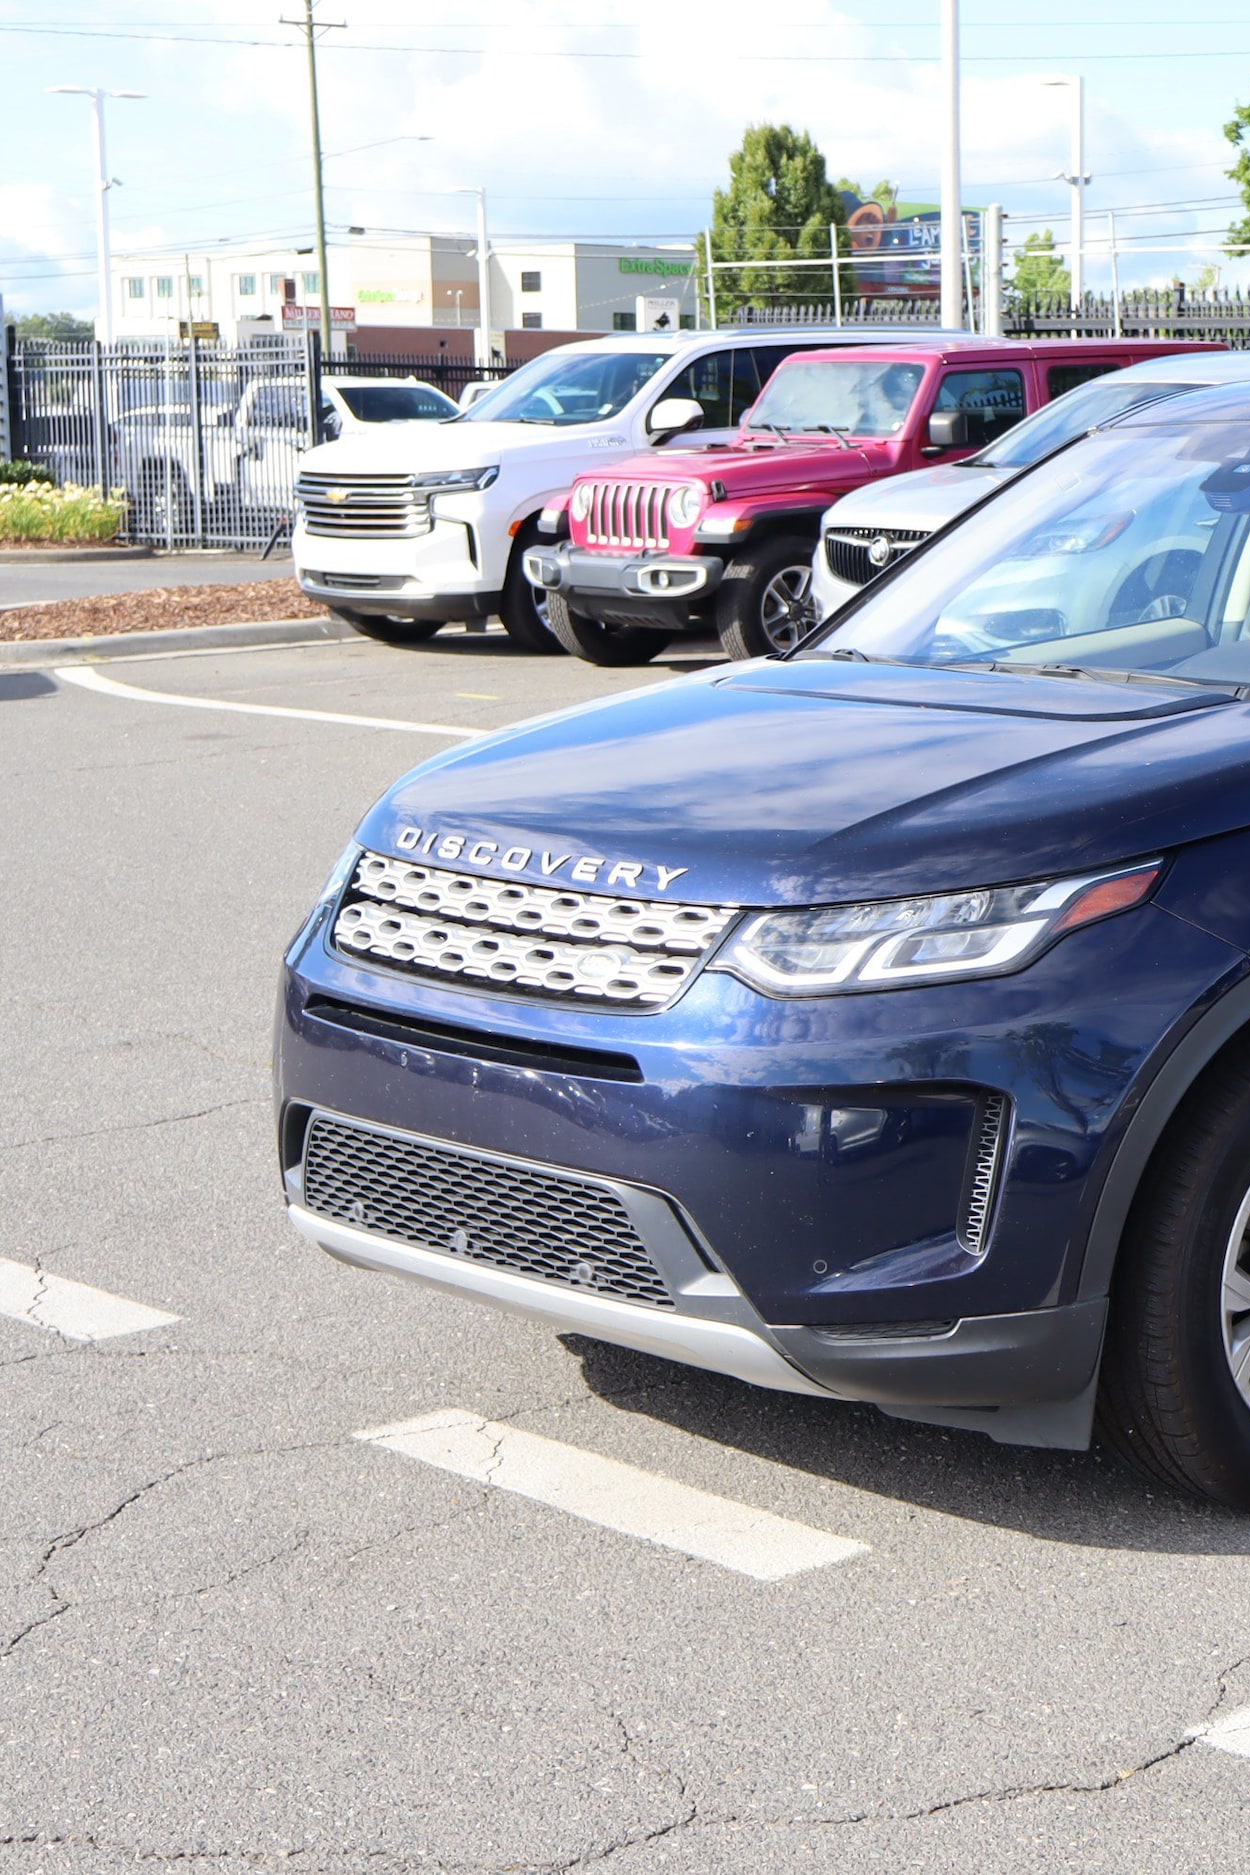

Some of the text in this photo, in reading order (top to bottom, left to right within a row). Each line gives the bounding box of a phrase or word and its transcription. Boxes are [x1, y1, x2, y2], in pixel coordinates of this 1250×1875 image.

[284, 307, 354, 320] MILER IANO
[396, 826, 688, 891] DISCOVERY
